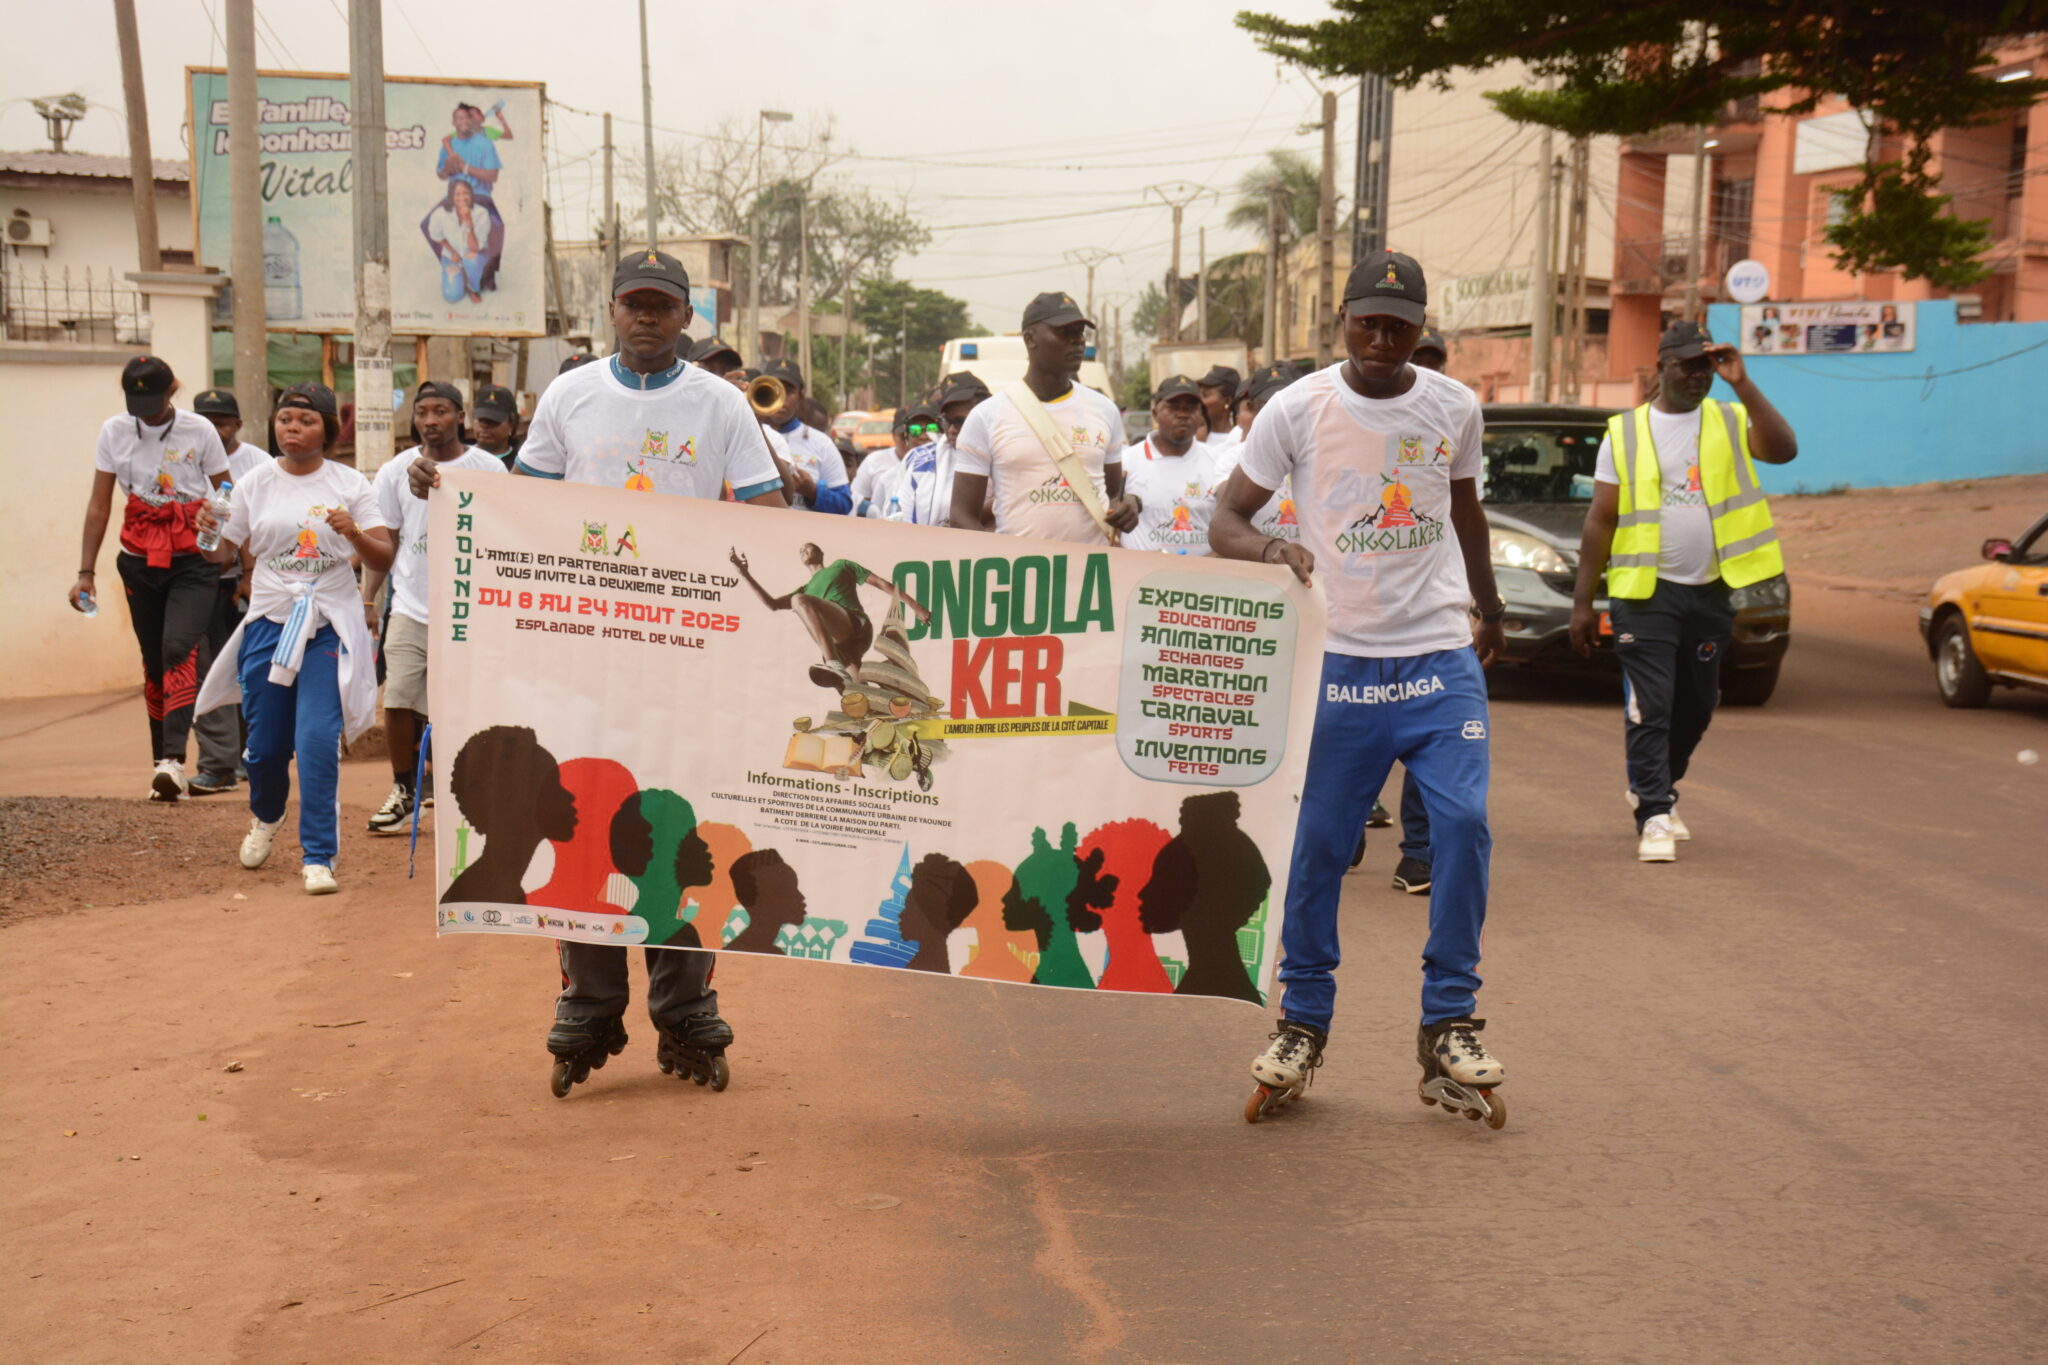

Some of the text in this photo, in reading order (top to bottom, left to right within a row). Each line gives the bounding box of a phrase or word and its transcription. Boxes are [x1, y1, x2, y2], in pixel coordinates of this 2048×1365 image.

[209, 100, 229, 126] E
[258, 126, 352, 154] onheu
[1148, 528, 1208, 545] ONGOLAKE
[1335, 522, 1444, 554] ONGOLAKER
[452, 491, 473, 641] YAOUNDE
[476, 548, 534, 564] L'AMI(E)
[558, 556, 648, 577] PARTENARIAT
[652, 568, 686, 582] AVEC
[690, 572, 706, 584] LA
[496, 566, 721, 602] VOUS INVITE LA DEUXIEME EDITION
[892, 553, 1114, 641] ONGOLA
[478, 587, 740, 632] DU 8 AU 24 AOUT 2025
[1138, 587, 1284, 620] EXPOSITIONS
[516, 618, 704, 650] ESPLANADE HOTEL DE VILLE
[1158, 610, 1257, 632] EDUCATIONS
[1141, 626, 1277, 656] ANIMATIONS
[1158, 650, 1244, 670] ECHANGES
[950, 636, 1064, 720] KER
[1142, 664, 1268, 692] MARATHON
[1327, 675, 1445, 704] BALENCIAGA
[1152, 685, 1254, 706] SPECTACLES
[944, 720, 1108, 734] L'AMOUR ENTRE LES PEUPLES DE LA CITÉ CAPITALE
[1140, 700, 1260, 726] CARNAVAL
[1168, 724, 1233, 740] SPORTS
[1134, 739, 1266, 765] INVENTIONS
[1168, 760, 1220, 776] FETES
[747, 770, 840, 794] Informations
[854, 784, 939, 806] Inscriptions
[772, 790, 810, 800] DIRECTION
[825, 798, 856, 807] AFFAIRES
[858, 802, 890, 810] SOCIALES
[712, 792, 756, 803] CULTURELLES
[768, 798, 804, 808] SPORTIVES
[826, 806, 876, 818] COMMUNAUTE
[878, 812, 907, 822] URBAINE
[918, 817, 952, 828] YAOUNDE
[760, 807, 794, 816] BATIMENT
[796, 812, 828, 821] DERRIERE
[839, 816, 867, 826] MAISON
[820, 823, 844, 832] VOIRIE
[844, 826, 886, 836] MUNICIPALE
